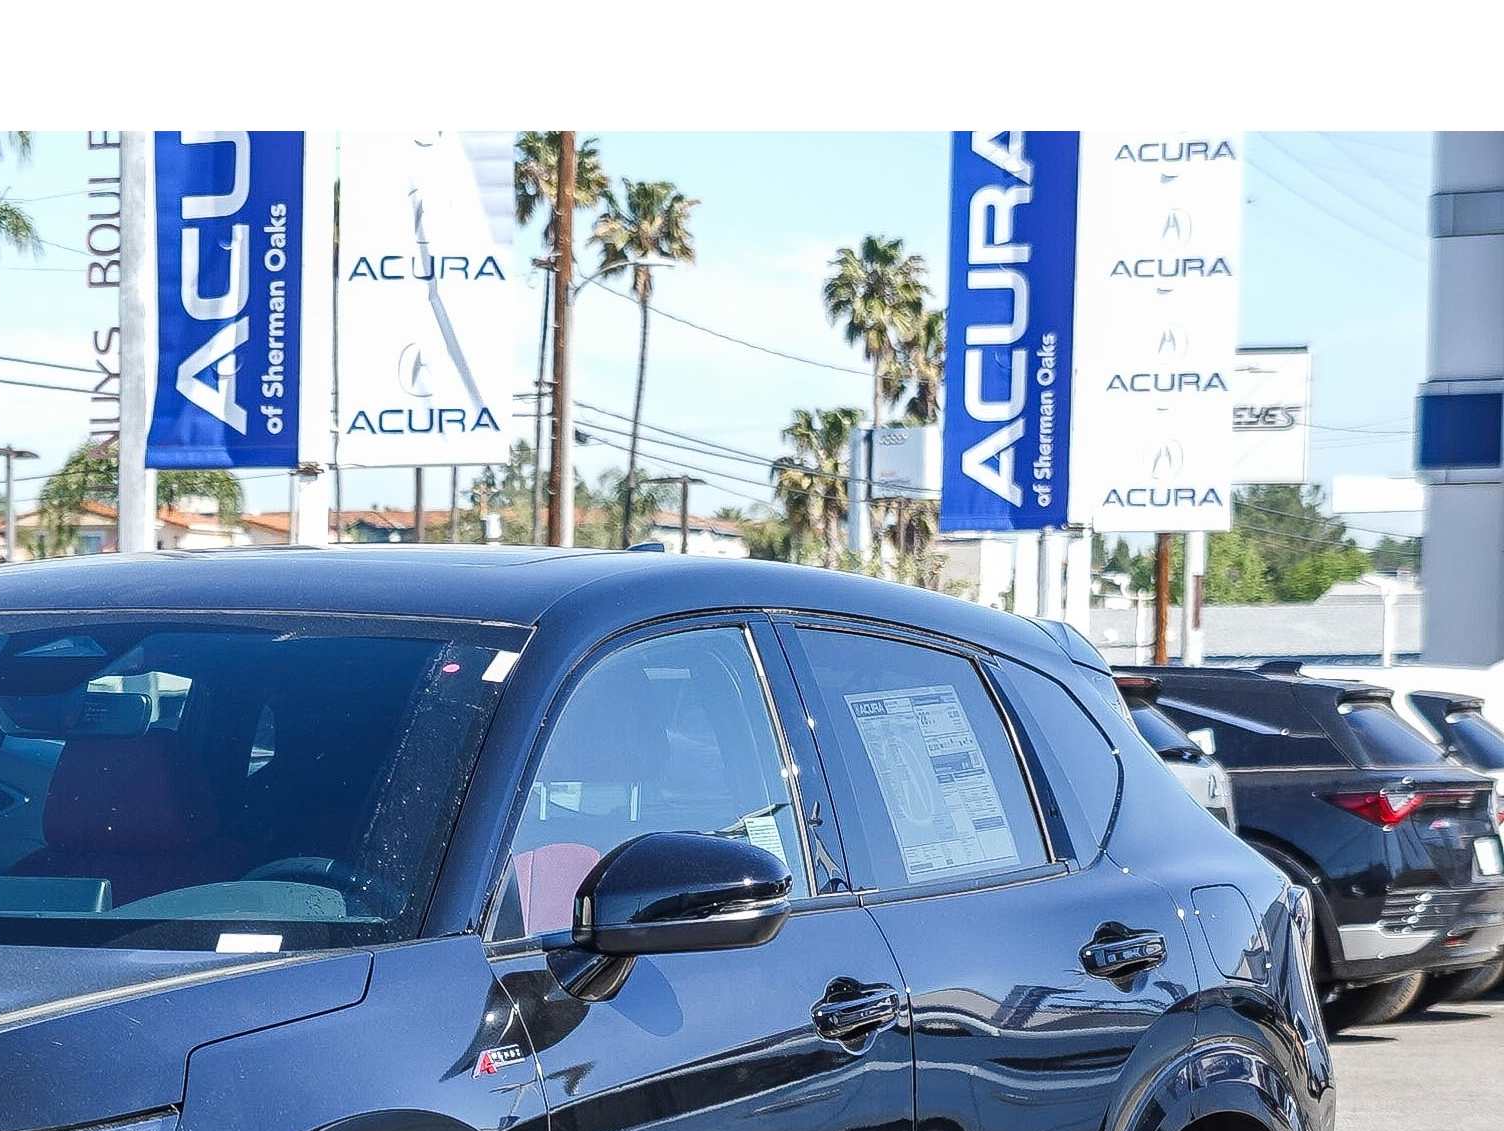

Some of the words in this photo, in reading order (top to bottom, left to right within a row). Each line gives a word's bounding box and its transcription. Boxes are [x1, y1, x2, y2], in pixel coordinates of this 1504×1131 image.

[1115, 141, 1236, 162] ACURA
[264, 203, 287, 272] Oaks
[348, 255, 505, 281] ACURA
[1110, 257, 1232, 278] ACURA
[962, 131, 1032, 507] ACURA
[261, 281, 285, 398] Sherman
[1037, 333, 1058, 387] Oaks
[1106, 372, 1228, 392] ACURA
[261, 405, 283, 434] of
[347, 407, 500, 434] ACURA
[1034, 391, 1056, 480] Sherman
[1033, 482, 1053, 507] of
[1102, 487, 1223, 507] ACURA
